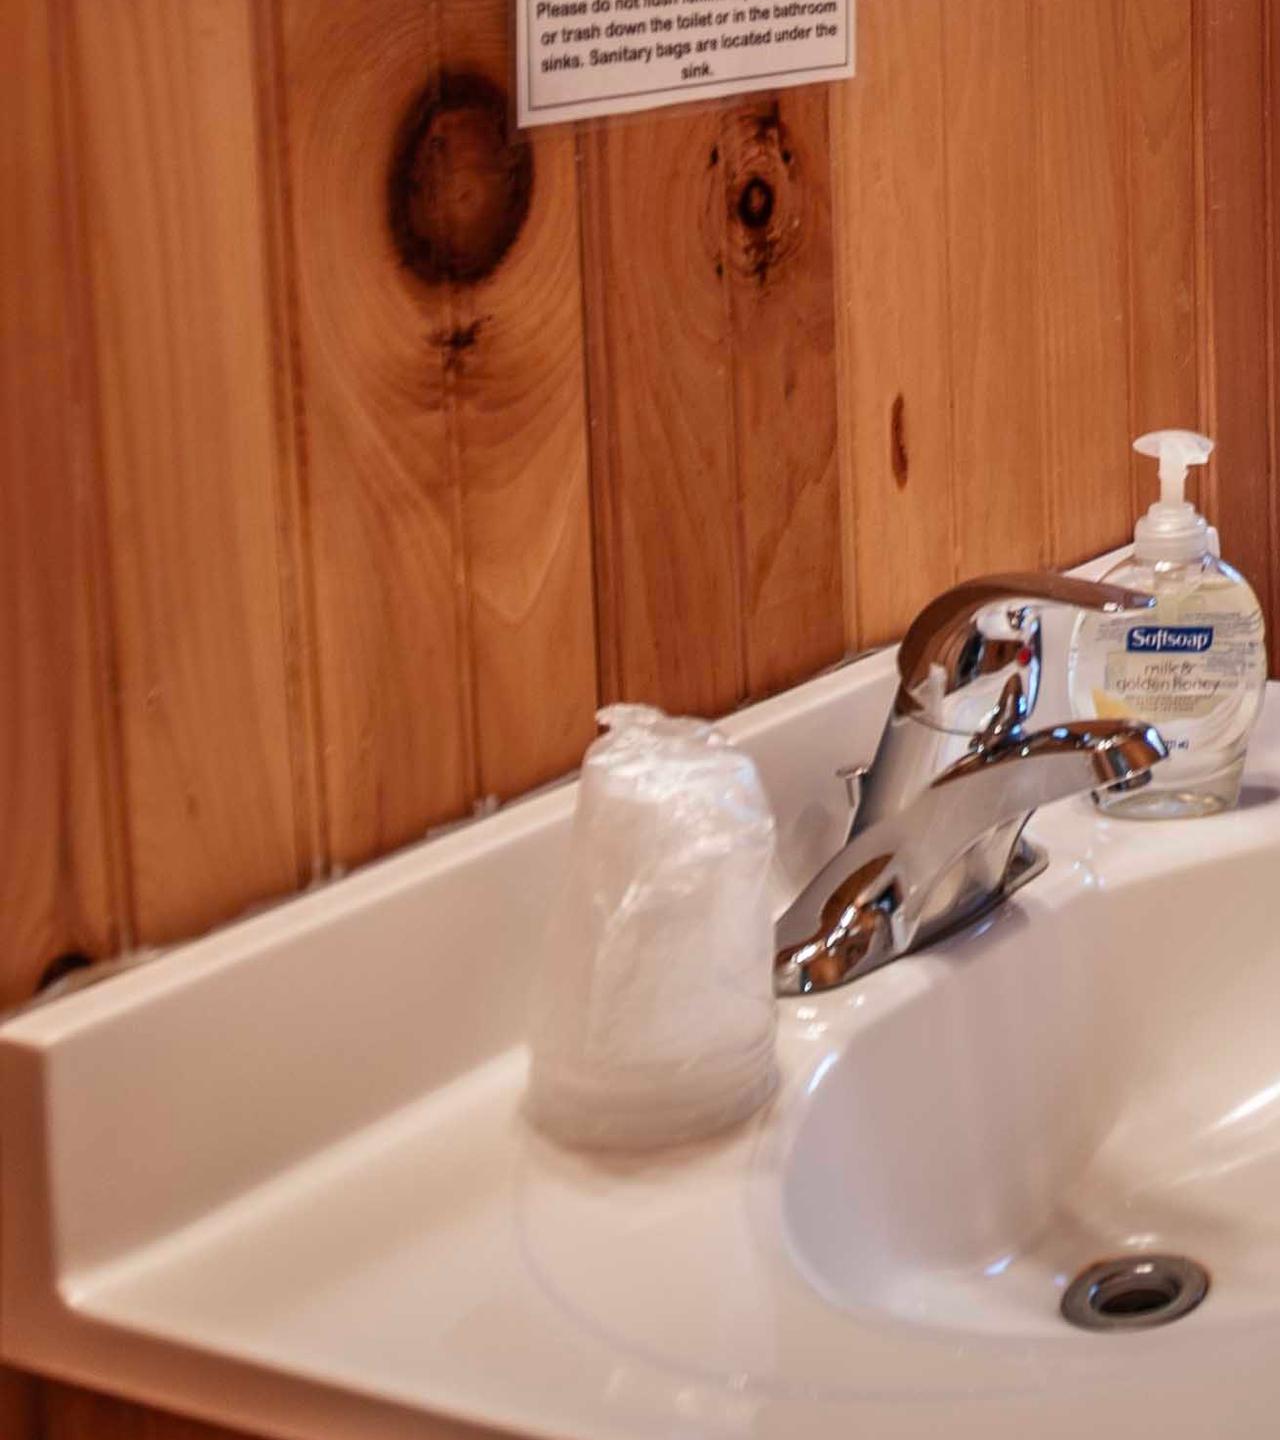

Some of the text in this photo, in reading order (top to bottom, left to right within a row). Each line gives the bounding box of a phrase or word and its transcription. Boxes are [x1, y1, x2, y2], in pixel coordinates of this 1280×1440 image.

[536, 0, 587, 19] Please
[541, 1, 837, 46] or trash down the toilet or in the bathroom
[541, 22, 838, 72] sinks. Sanitary bags are located under the
[1132, 629, 1209, 652] Softsoap
[1143, 661, 1178, 676] milk
[1116, 675, 1220, 697] golden honey
